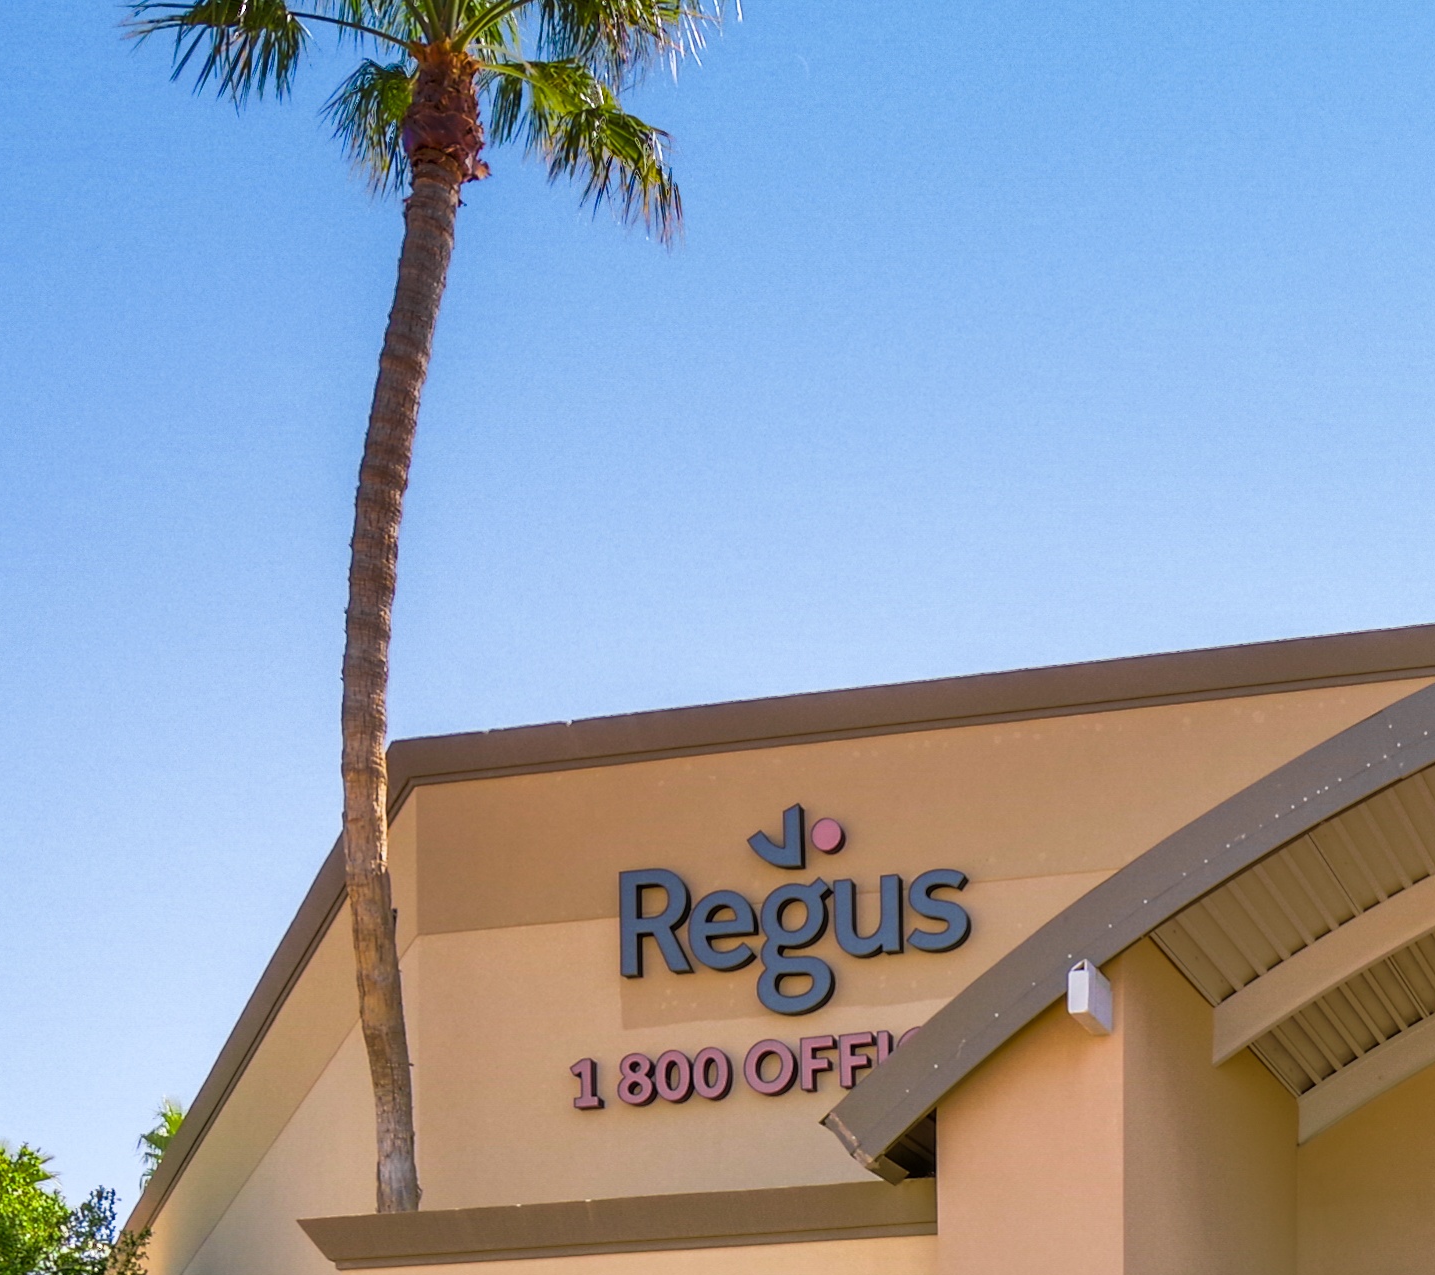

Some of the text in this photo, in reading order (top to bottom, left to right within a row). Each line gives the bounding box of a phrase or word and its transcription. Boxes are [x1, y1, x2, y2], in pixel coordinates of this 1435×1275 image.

[619, 868, 972, 1015] Regus
[570, 1027, 924, 1110] 1 800 OFFI
